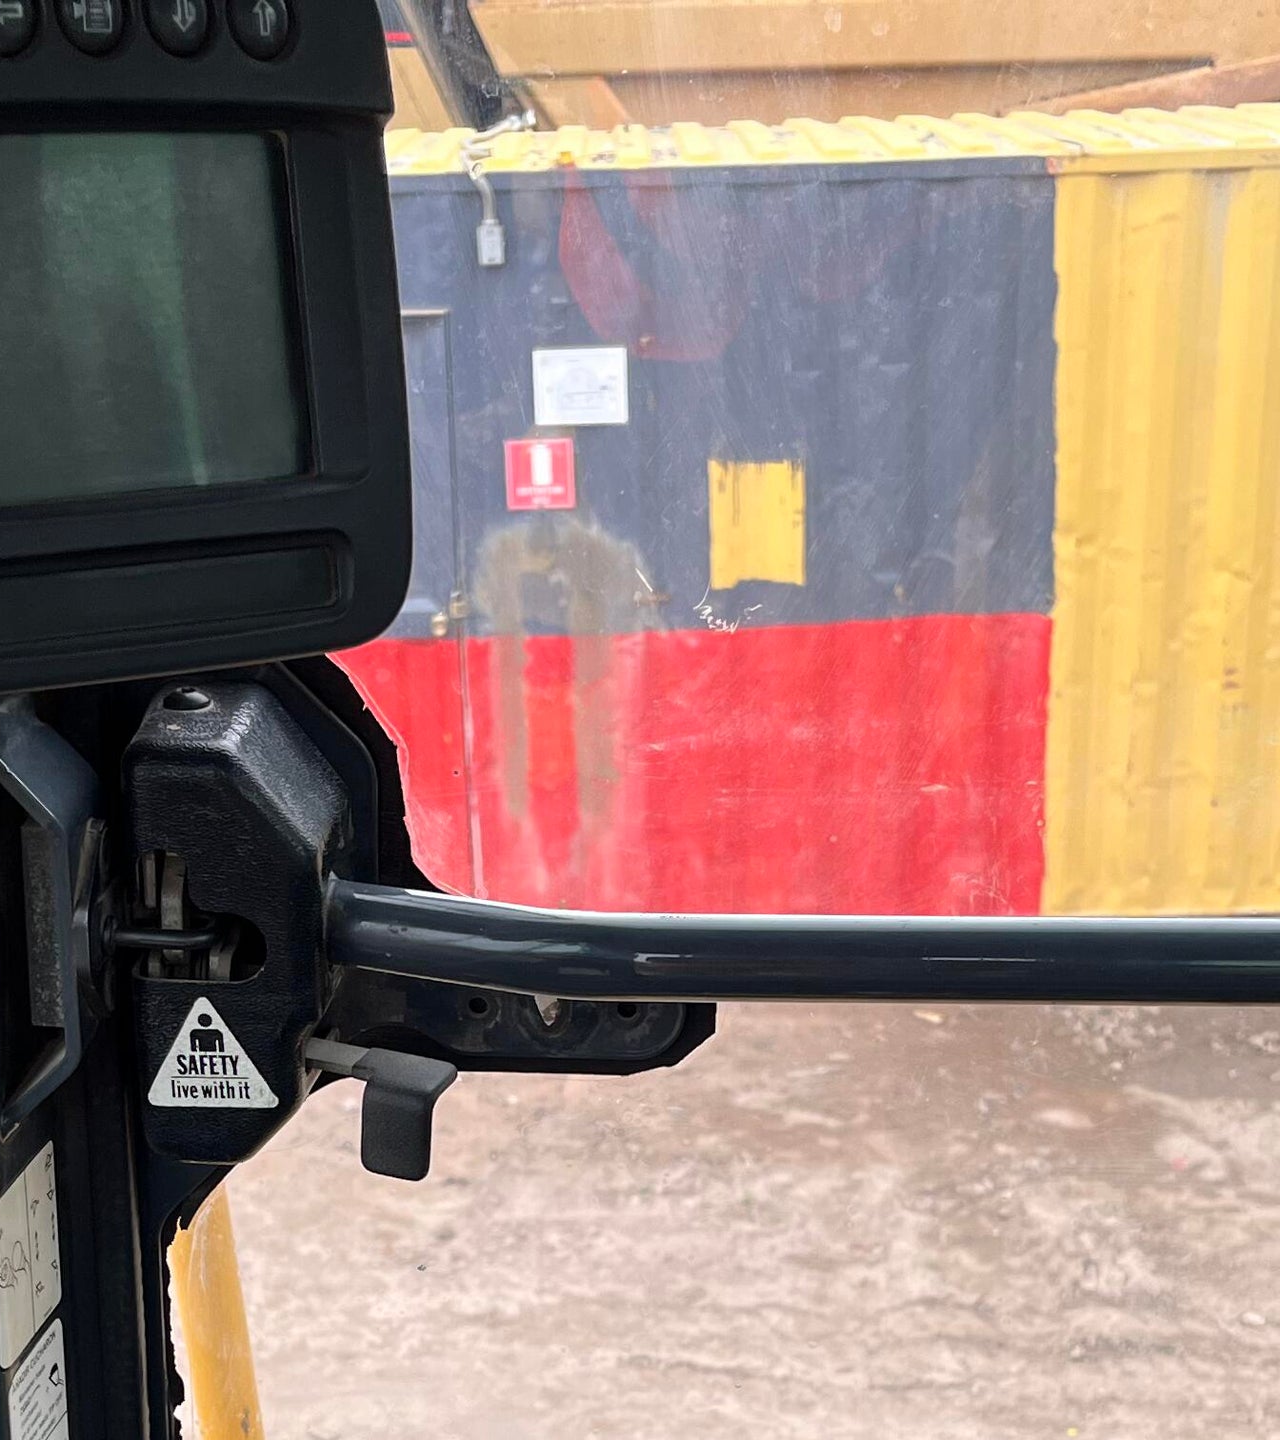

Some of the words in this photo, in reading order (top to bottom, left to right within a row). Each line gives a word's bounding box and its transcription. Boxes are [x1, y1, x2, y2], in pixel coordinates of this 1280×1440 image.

[176, 1054, 239, 1076] SAFETY
[171, 1079, 199, 1098] live
[201, 1081, 236, 1099] with
[239, 1081, 251, 1099] it
